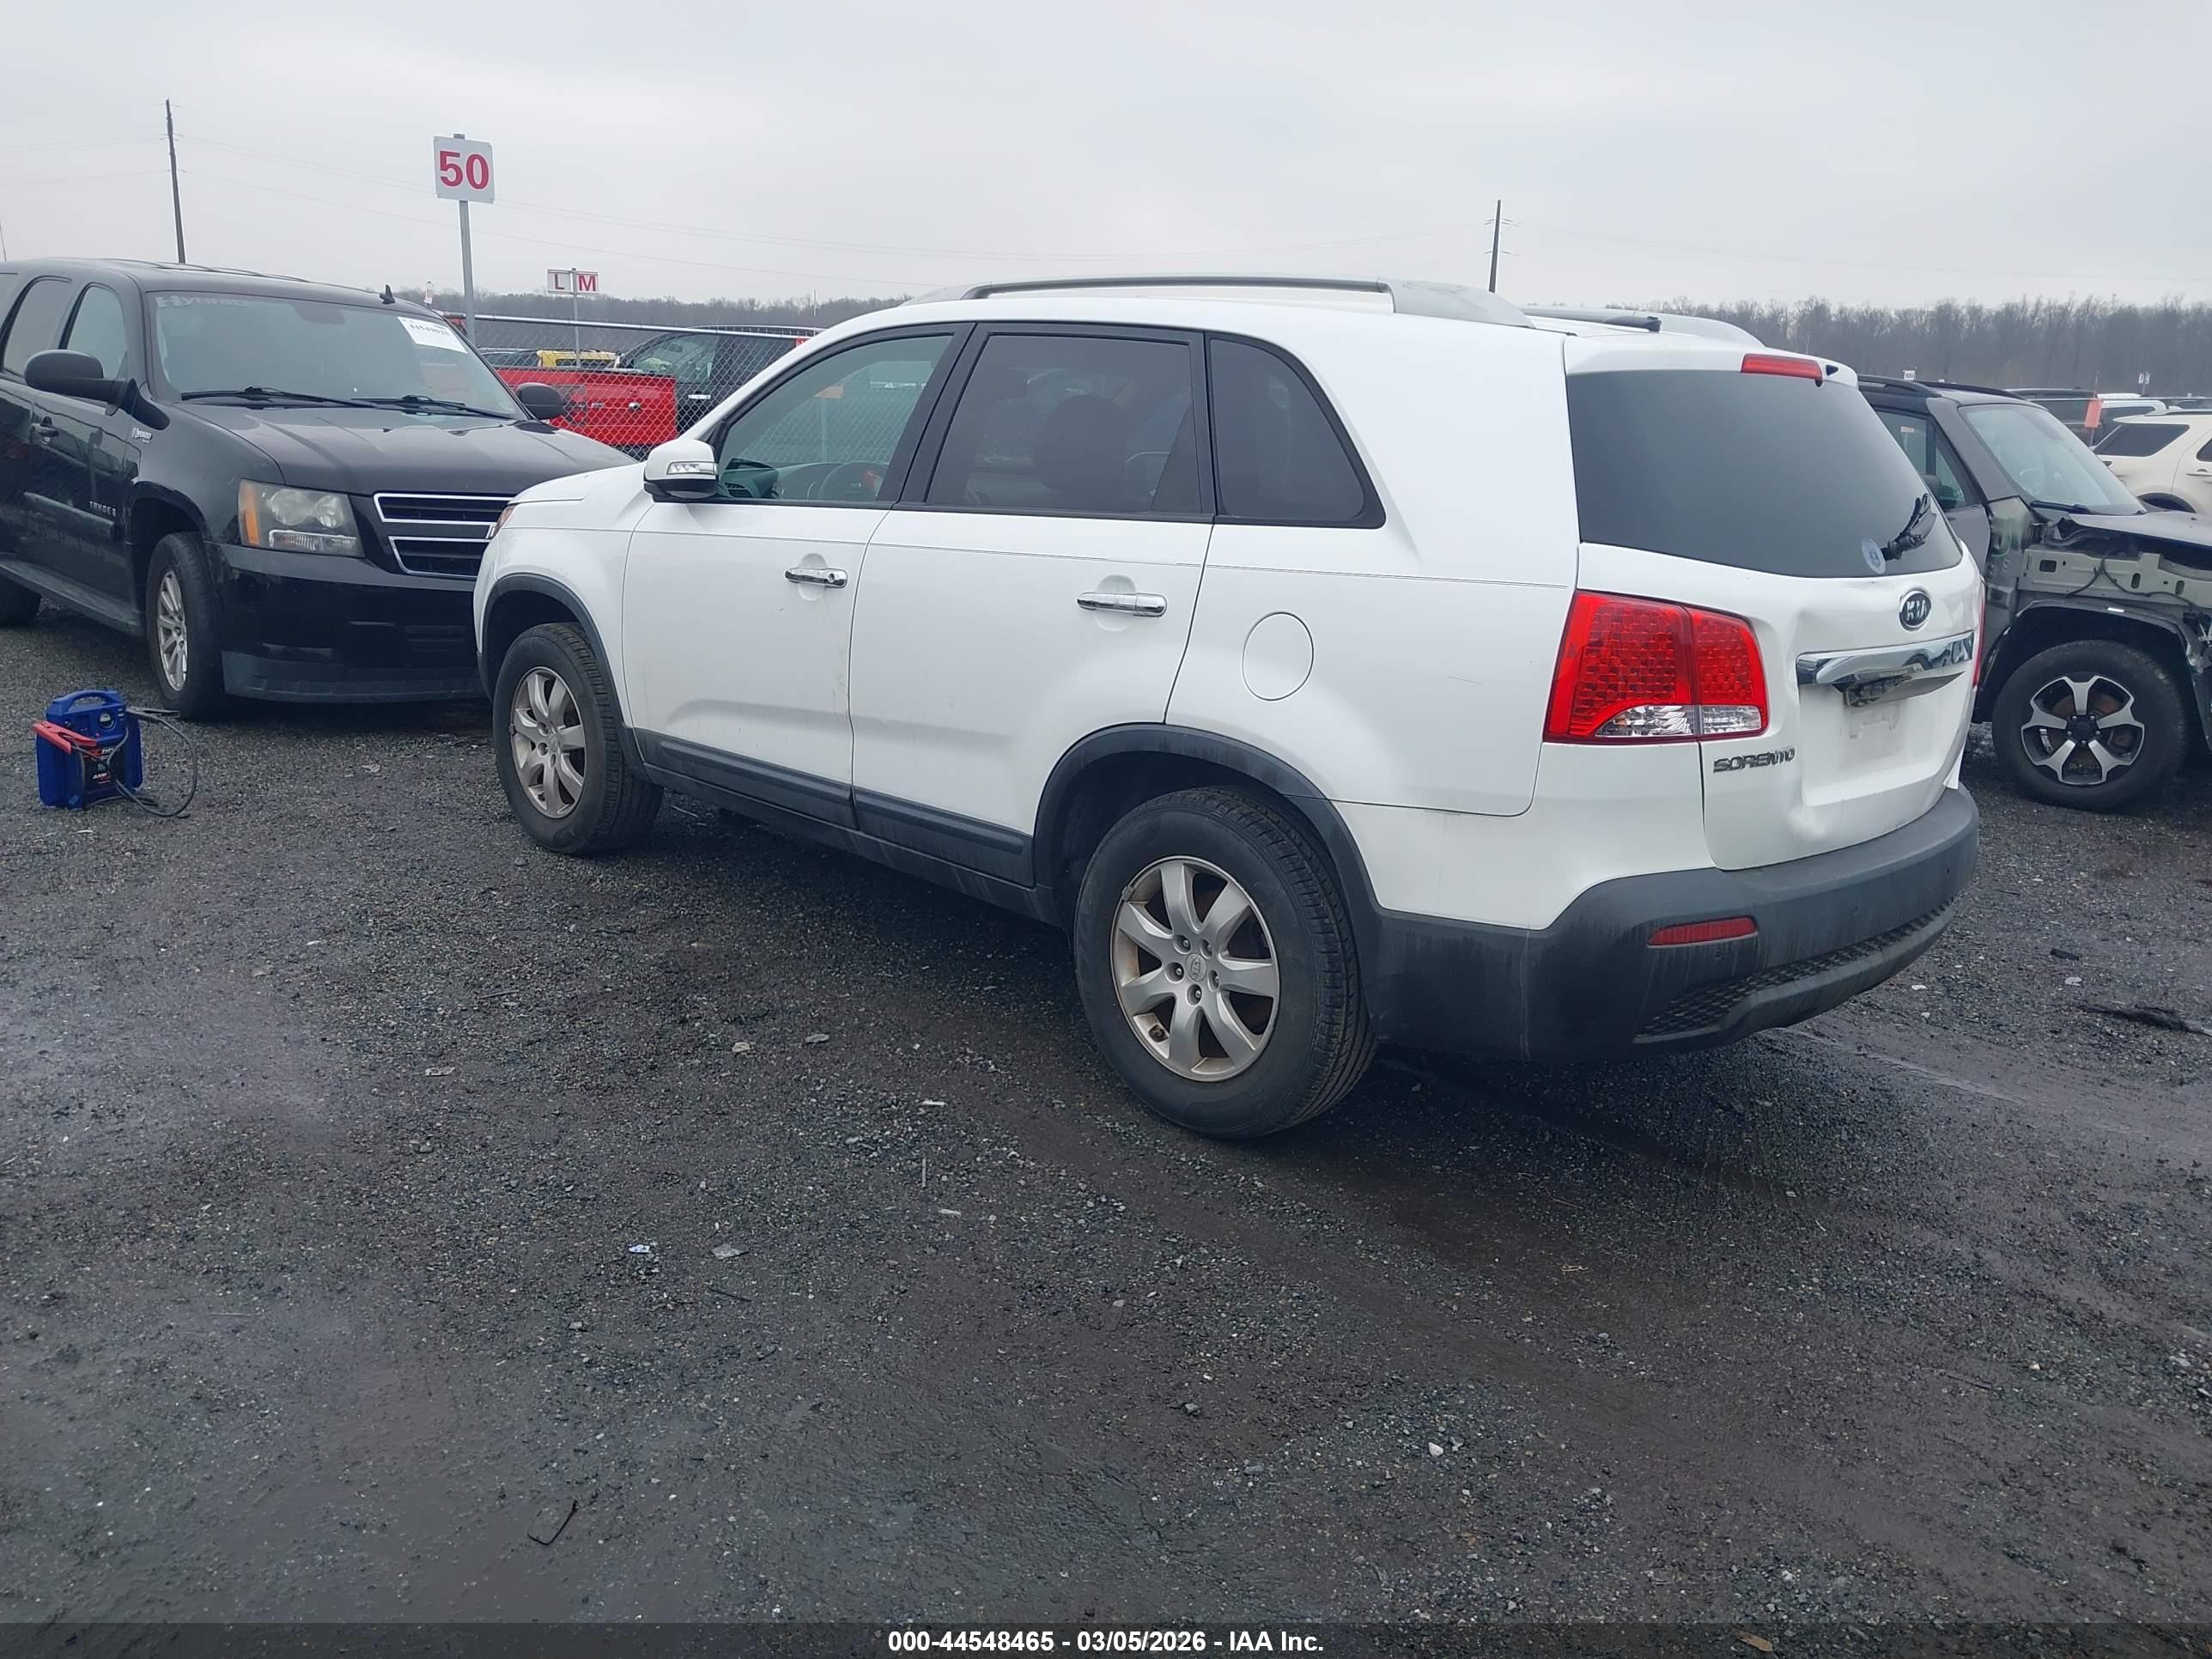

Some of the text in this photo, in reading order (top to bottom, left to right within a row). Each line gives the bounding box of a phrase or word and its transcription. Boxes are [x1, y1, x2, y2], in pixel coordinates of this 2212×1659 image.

[439, 150, 489, 190] 50
[554, 274, 597, 292] L M
[1713, 747, 1796, 773] SORENTO
